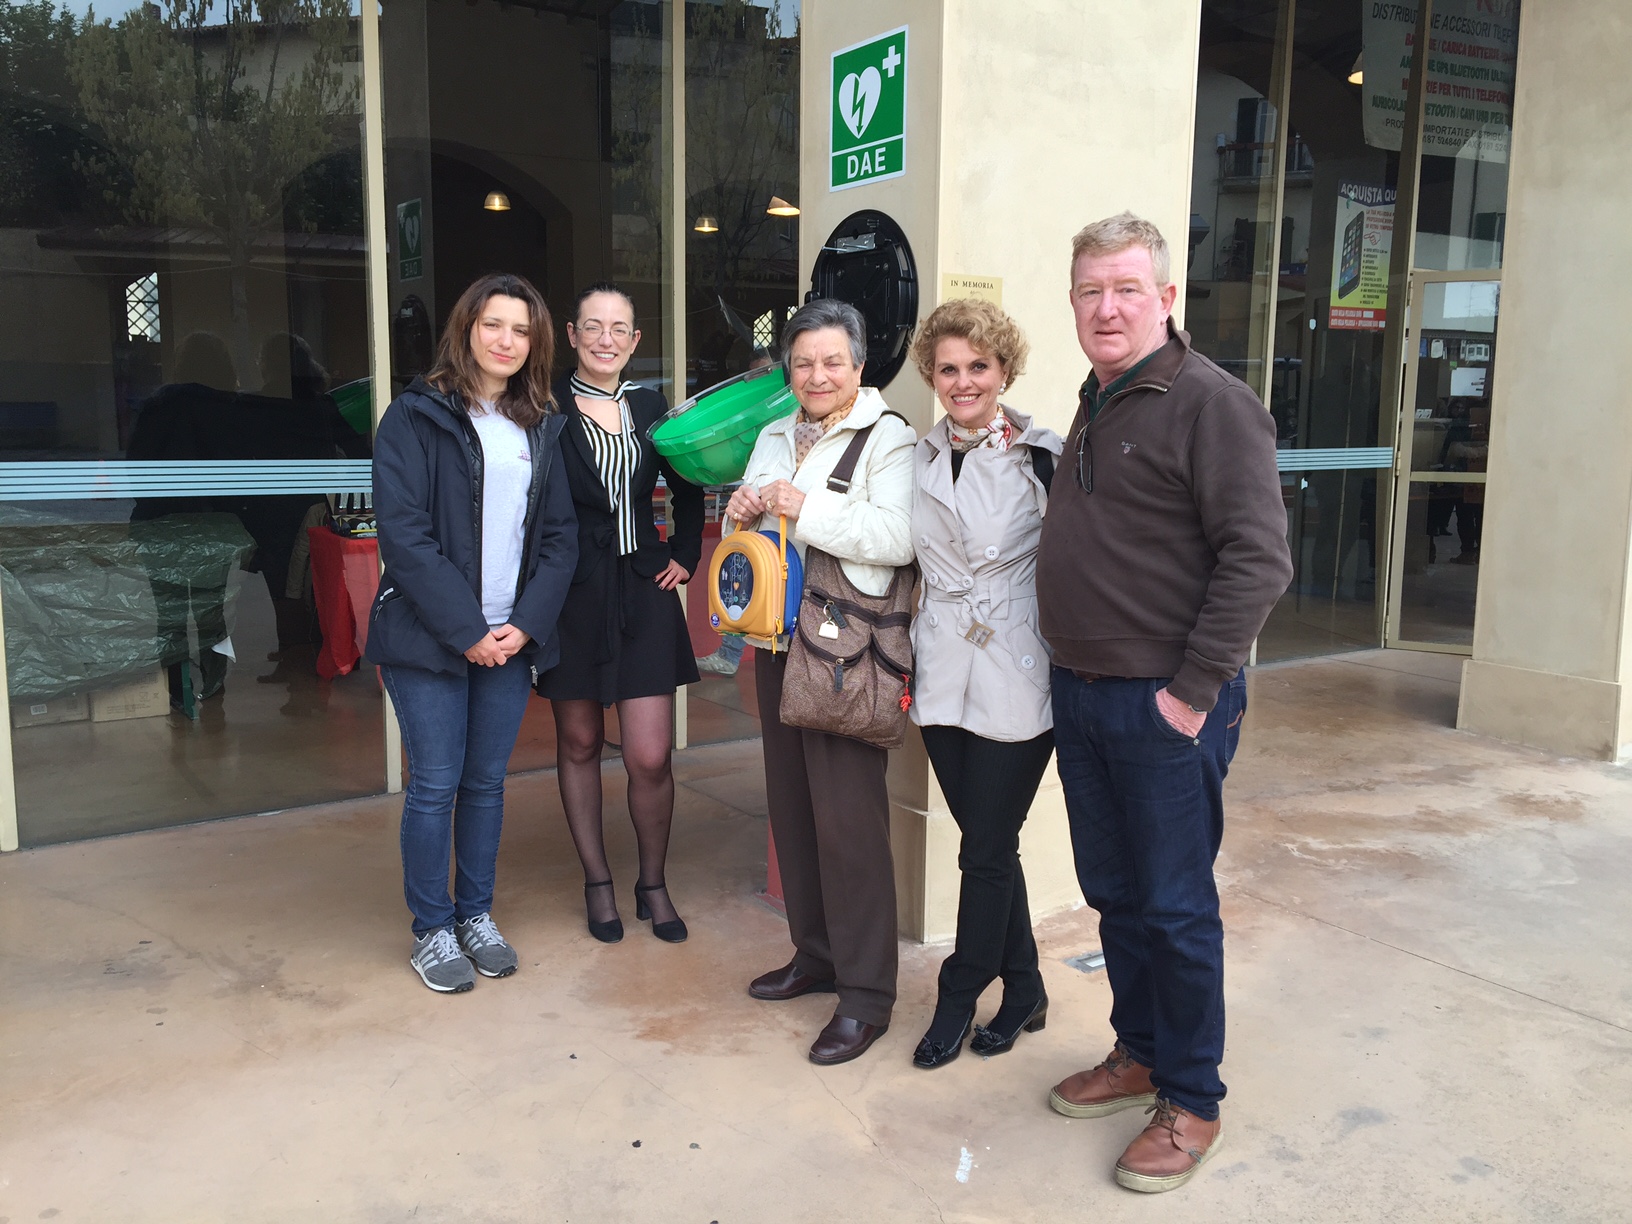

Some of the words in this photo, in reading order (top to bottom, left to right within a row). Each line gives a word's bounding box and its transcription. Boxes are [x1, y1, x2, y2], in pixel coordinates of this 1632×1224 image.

[1441, 15, 1490, 38] ACCESSORI
[1441, 41, 1467, 55] CARICA
[1436, 60, 1449, 75] GPS
[1450, 61, 1490, 81] BLUETOOTH
[1439, 82, 1453, 97] PER
[1453, 84, 1471, 99] TUTTI
[1460, 107, 1475, 121] CAVI
[1490, 111, 1504, 125] PER
[1465, 128, 1470, 137] E
[847, 147, 886, 179] DAE
[1340, 183, 1383, 204] ACQUISTA
[962, 281, 994, 290] MEMORIA
